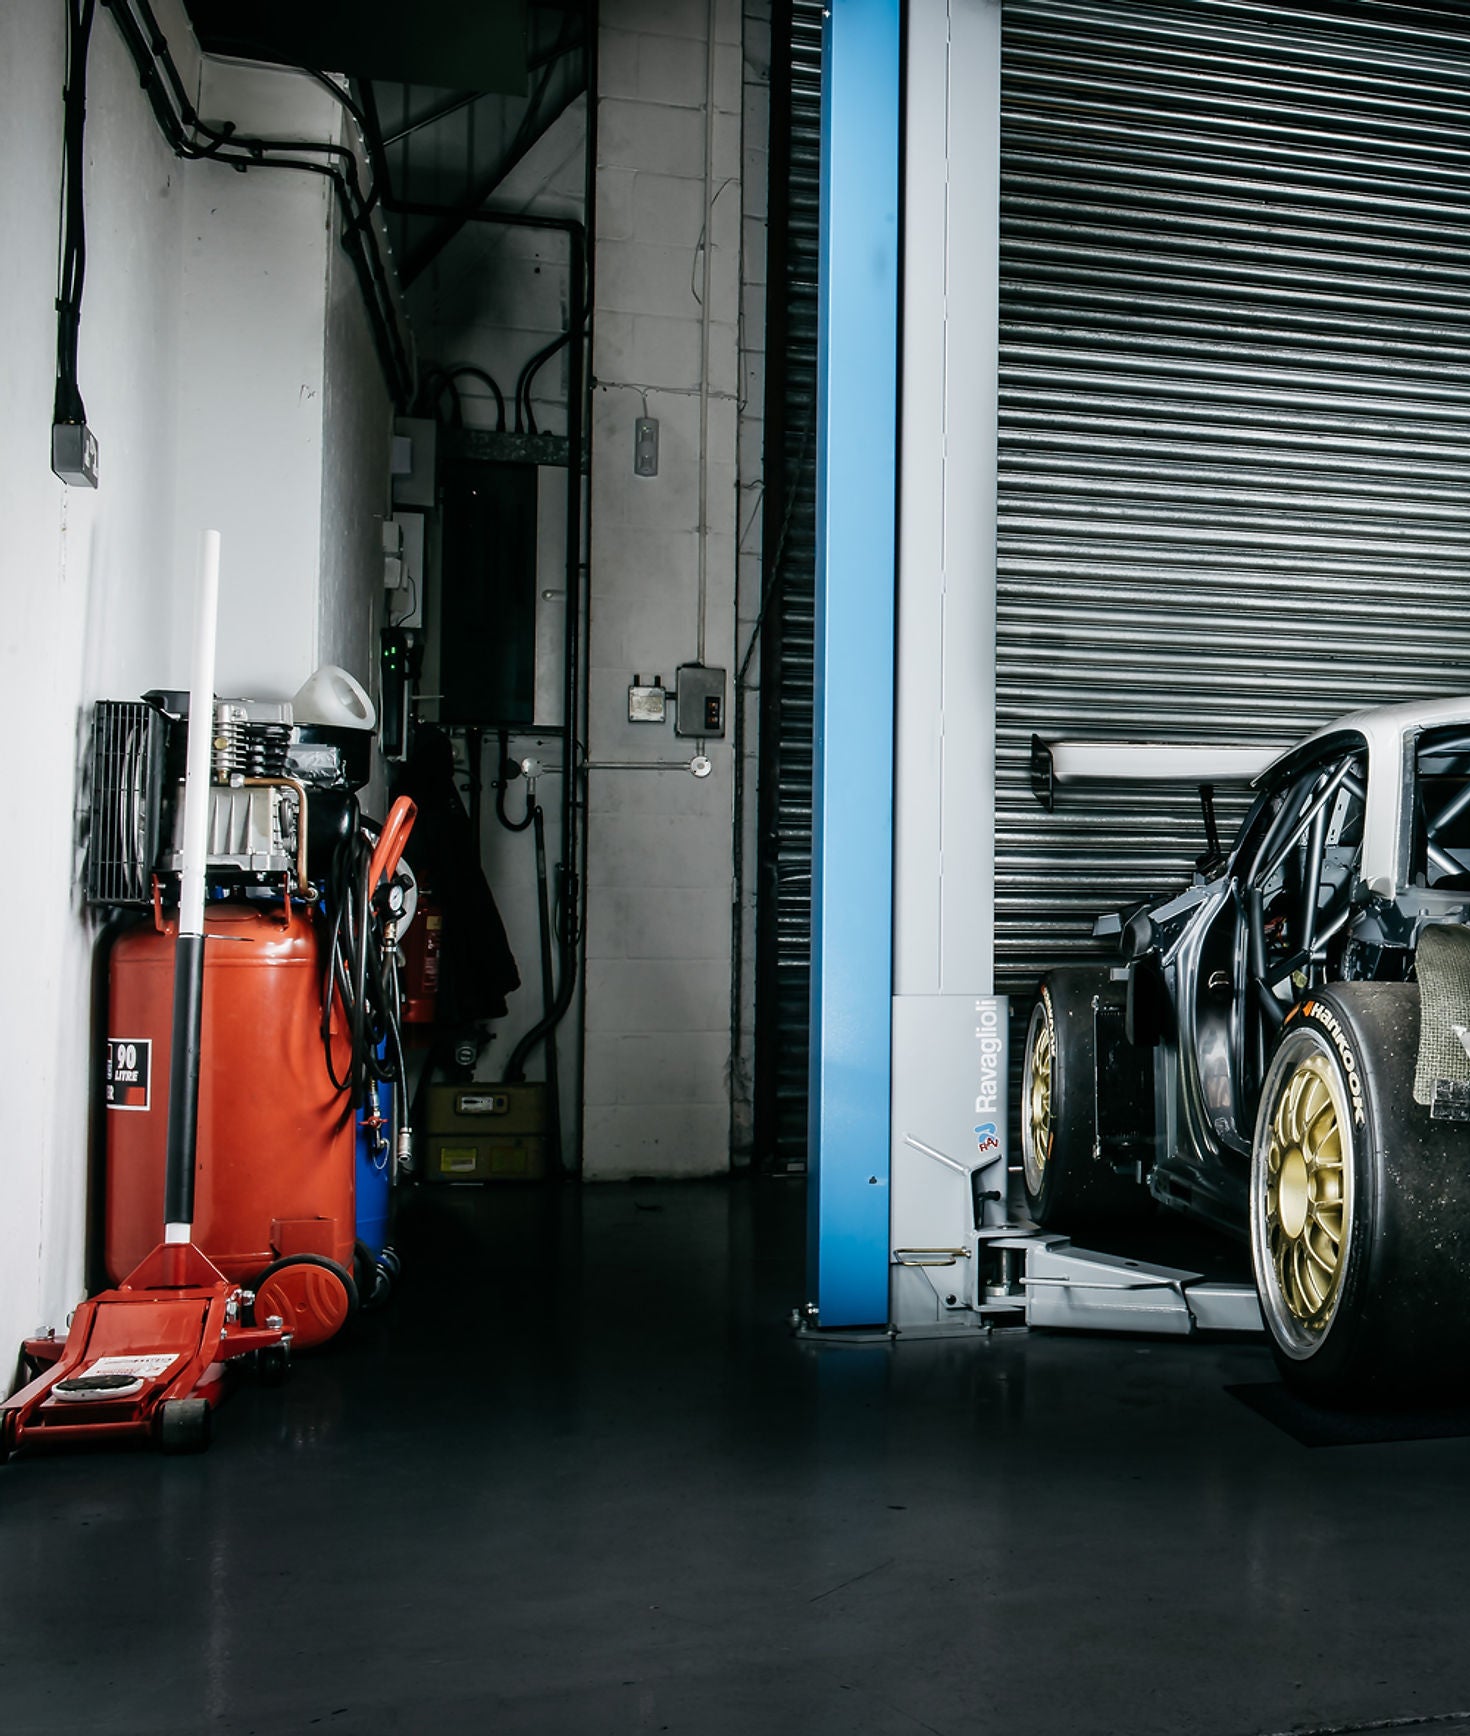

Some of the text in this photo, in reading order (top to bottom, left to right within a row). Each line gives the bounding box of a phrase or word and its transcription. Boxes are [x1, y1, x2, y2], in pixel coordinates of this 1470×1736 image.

[117, 1044, 137, 1069] 90
[975, 999, 1002, 1113] Ravaglioli
[114, 1070, 139, 1081] LITRE
[979, 1137, 998, 1152] RAV
